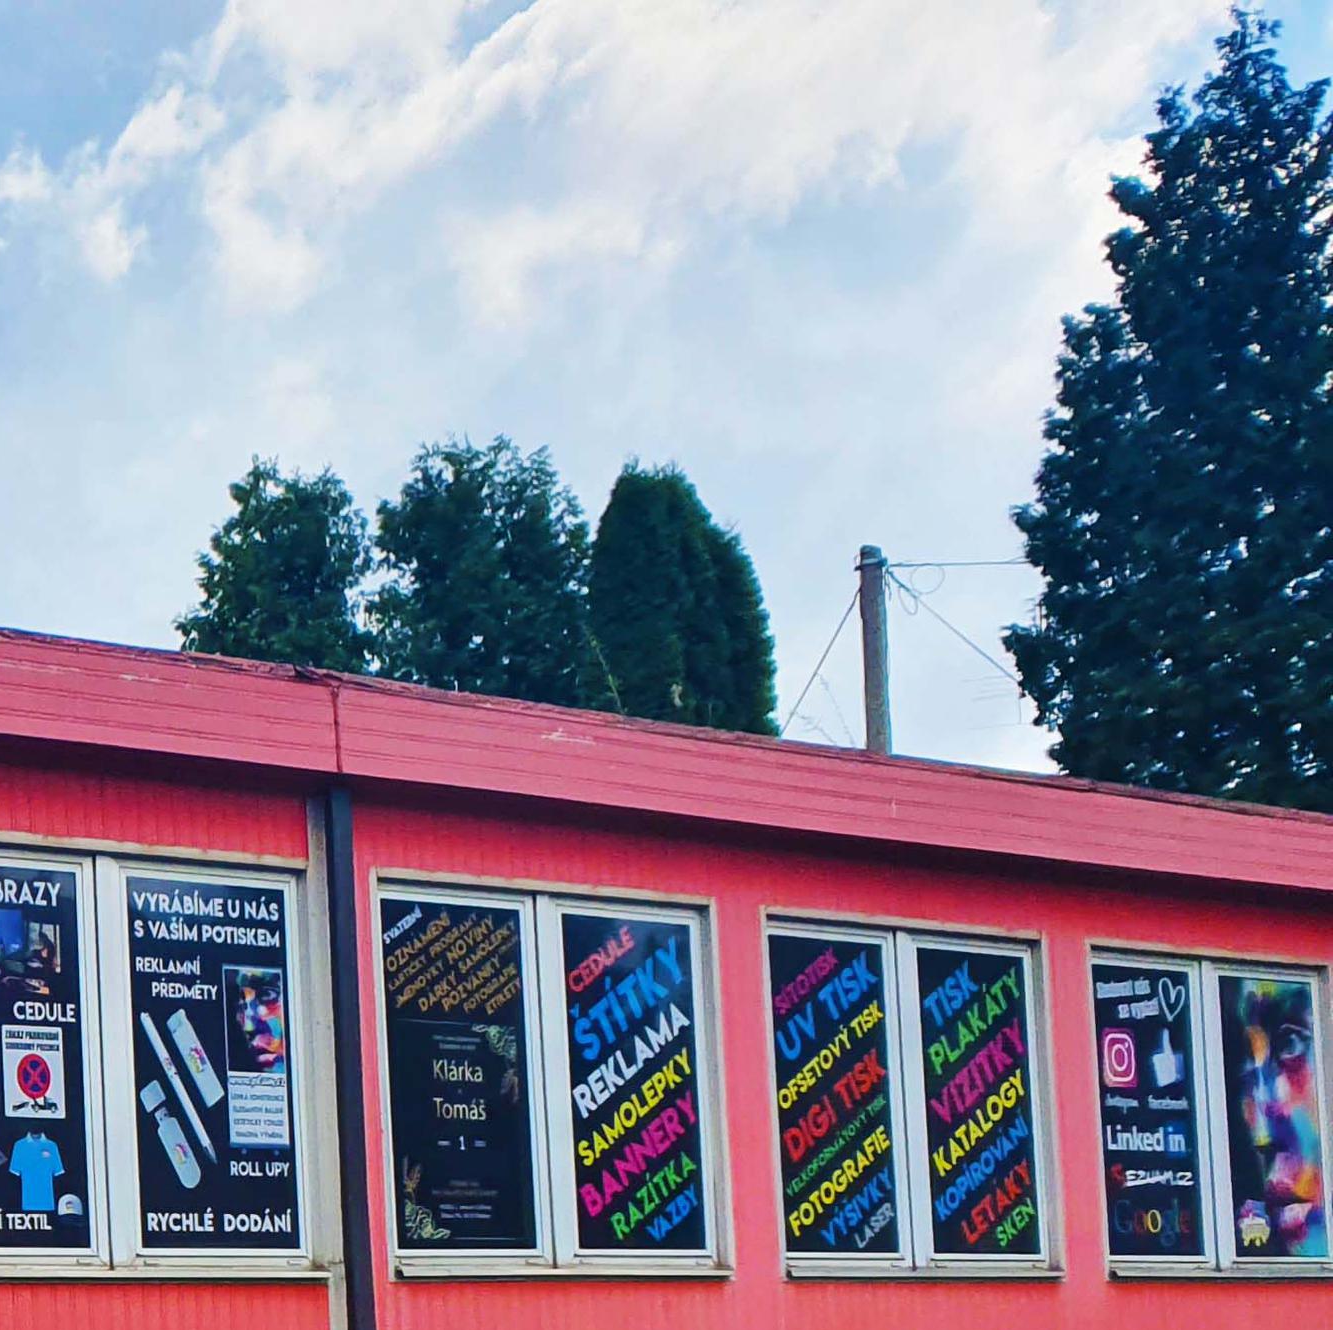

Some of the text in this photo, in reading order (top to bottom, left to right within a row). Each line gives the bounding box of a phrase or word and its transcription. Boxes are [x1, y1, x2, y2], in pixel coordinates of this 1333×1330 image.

[133, 889, 279, 921] VYRÁBÍME U NÁS
[133, 917, 280, 948] S VAŠÍM POTISKEM
[135, 955, 201, 975] REKLAMNÍ
[151, 978, 218, 1000] PŘEDMĚTY
[568, 925, 635, 992] CEDULE
[13, 1001, 76, 1023] CEDULE
[569, 936, 683, 1061] ŠTÍTKY
[776, 951, 879, 1061] UV TISK
[923, 960, 979, 1028] TISK
[928, 966, 1020, 1075] PLAKÁTY
[433, 1058, 484, 1082] Klárka
[573, 1002, 690, 1118] REKLAMA
[778, 1000, 884, 1109] OFSETOVÝ TISK
[930, 1018, 1026, 1123] VIZITKY
[433, 1097, 487, 1120] Tomáš
[578, 1047, 691, 1166] SAMOLEPKY
[783, 1048, 887, 1162] DIGI TISK
[933, 1068, 1025, 1177] KATALOGY
[230, 1161, 290, 1177] ROLL UPY
[579, 1090, 696, 1217] BANNERY
[789, 1125, 891, 1237] FOTOGRAFIE
[6, 1213, 52, 1230] TEXTIL
[147, 1207, 291, 1232] RYCHLÉ DODÁNÍ
[610, 1152, 697, 1240] RAZÍTKA
[646, 1184, 698, 1241] VAZBY
[961, 1158, 1031, 1245] LETÁKY
[996, 1197, 1036, 1247] SKEN
[1115, 1199, 1190, 1246] Google
